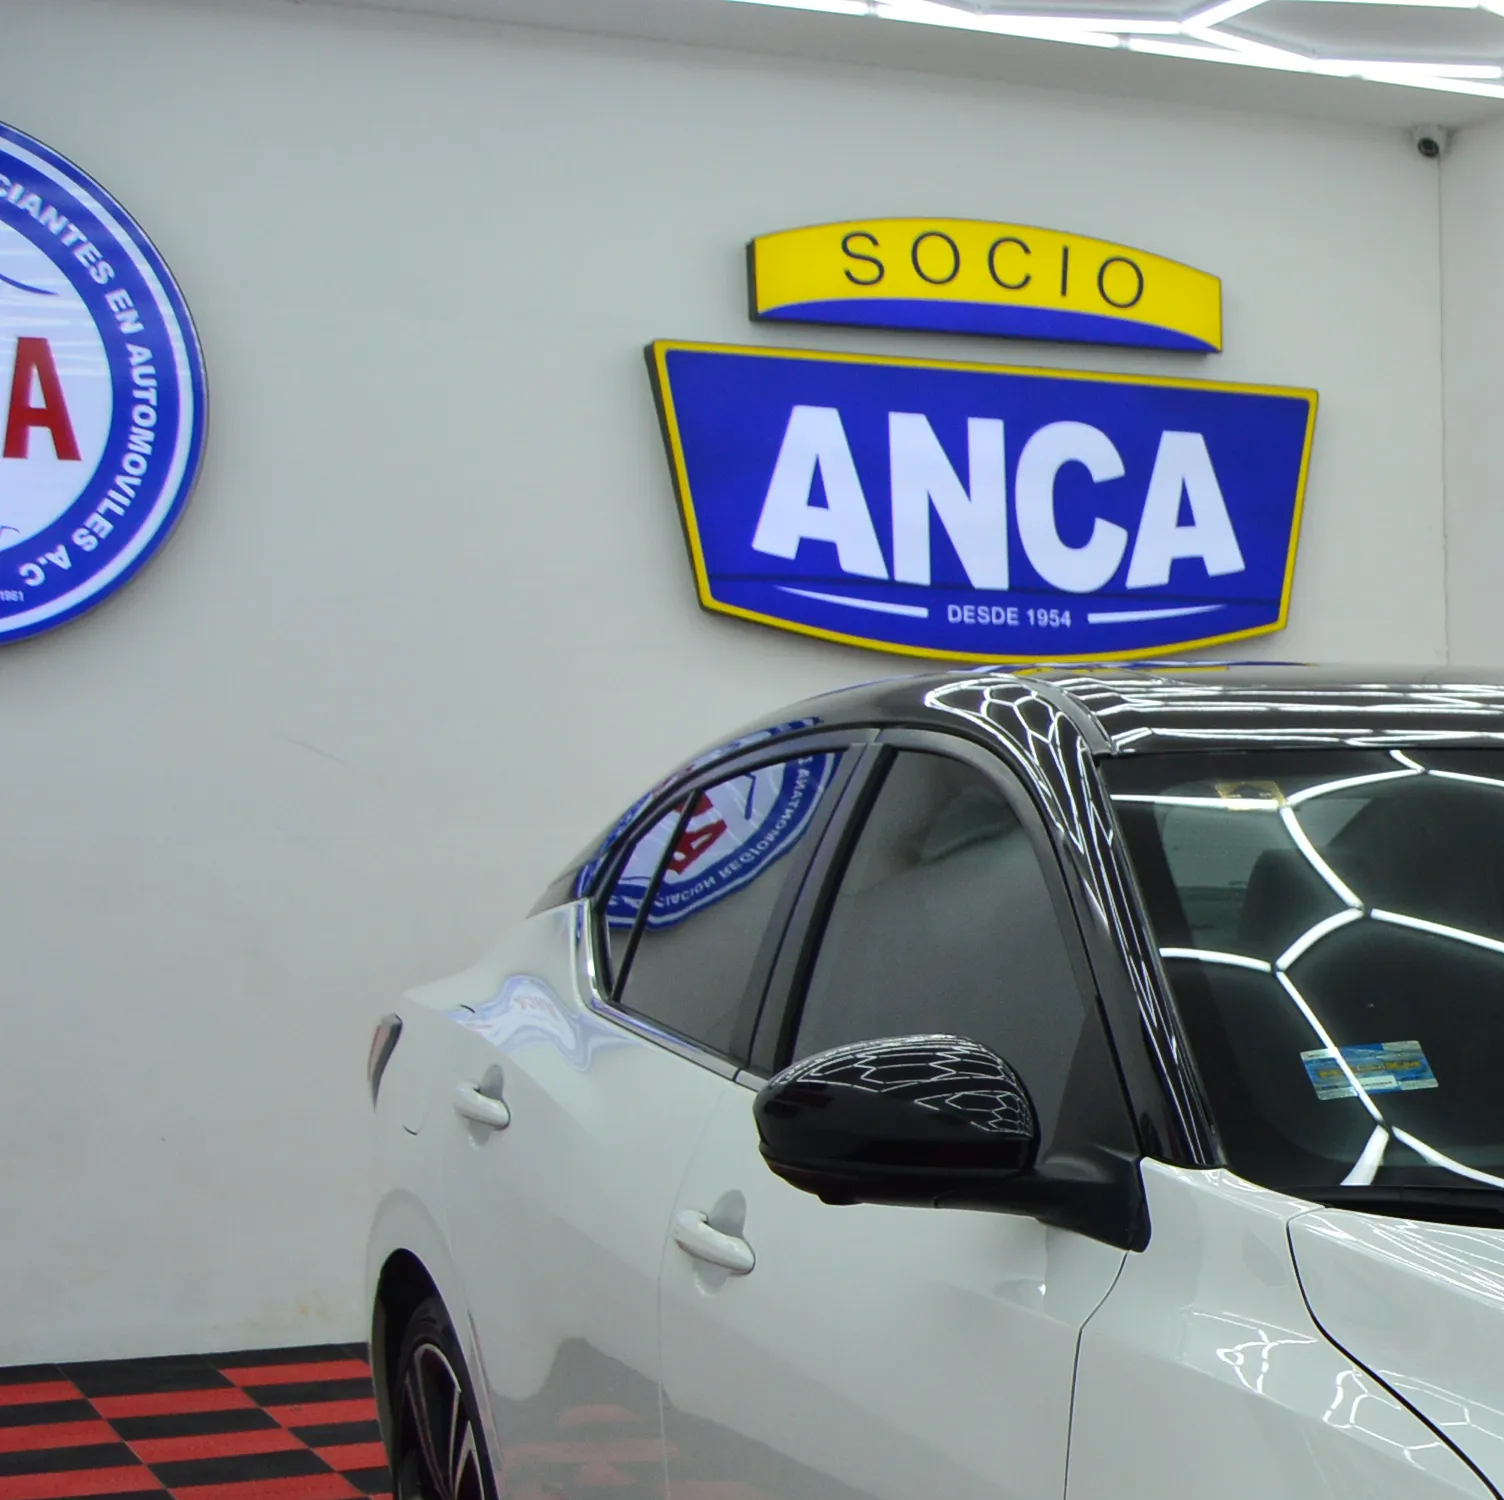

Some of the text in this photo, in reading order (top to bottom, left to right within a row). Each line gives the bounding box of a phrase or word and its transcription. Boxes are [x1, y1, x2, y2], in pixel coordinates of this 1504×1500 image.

[841, 231, 1144, 310] SOCIO
[104, 288, 145, 334] EN
[72, 343, 157, 552] AUTOMOVILES
[751, 404, 1246, 594] ANCA
[947, 604, 1071, 628] DESDE 1954
